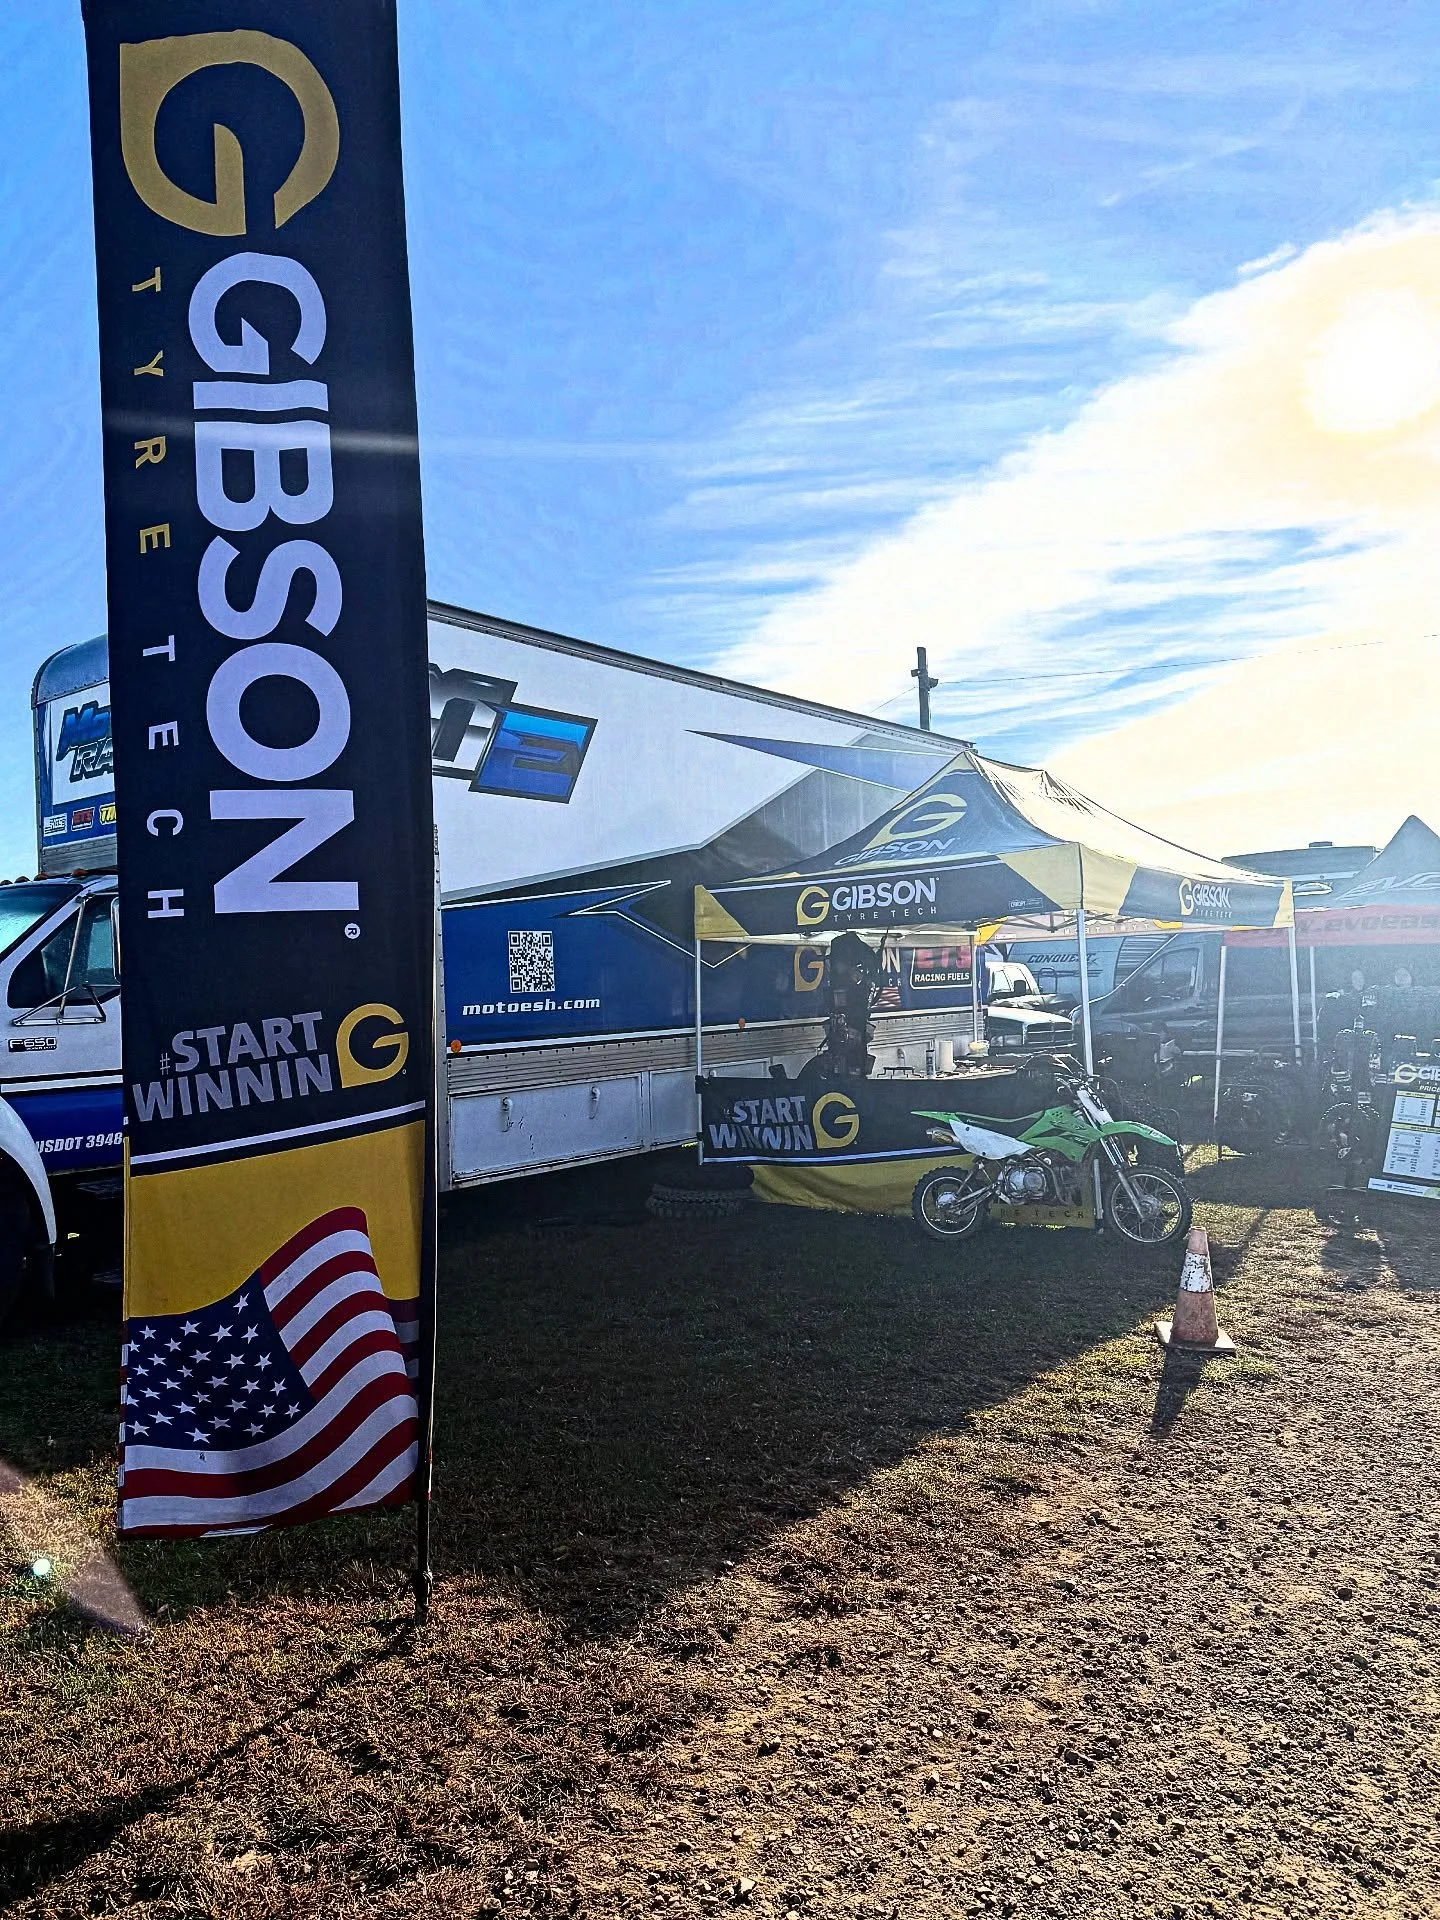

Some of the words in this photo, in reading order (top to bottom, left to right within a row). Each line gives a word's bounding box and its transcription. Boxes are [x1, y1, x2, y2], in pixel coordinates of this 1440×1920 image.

[132, 267, 170, 554] TYRE
[188, 252, 359, 914] GIBSON
[143, 634, 185, 919] TECH
[834, 838, 957, 866] GIBSON
[832, 878, 936, 910] GIBSON
[1192, 883, 1231, 908] GIBSON
[834, 912, 878, 922] TYRE
[891, 907, 936, 918] TECH
[1027, 952, 1097, 963] CONQUET
[914, 973, 946, 983] RACING
[947, 972, 970, 981] FUELS
[462, 999, 600, 1015] motoesh.com
[159, 1011, 323, 1076] #START
[37, 1136, 83, 1153] USDOT
